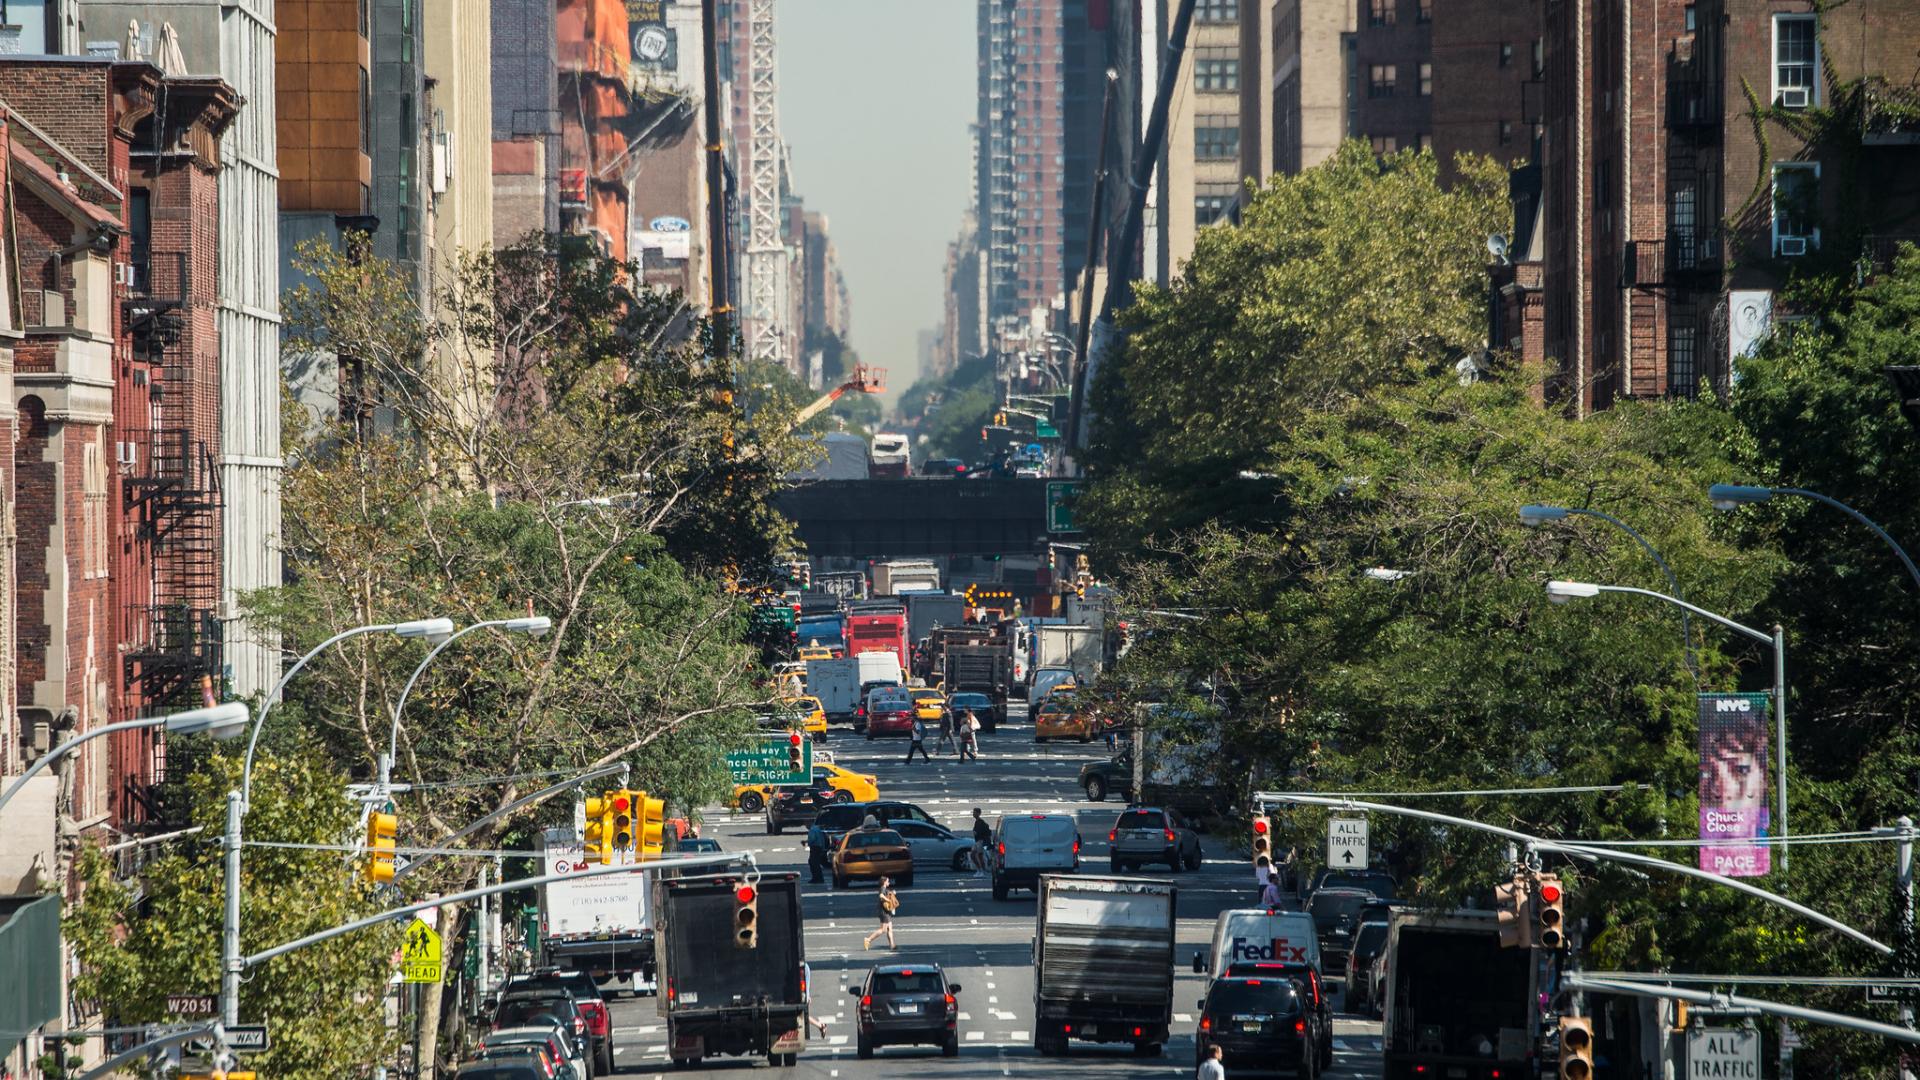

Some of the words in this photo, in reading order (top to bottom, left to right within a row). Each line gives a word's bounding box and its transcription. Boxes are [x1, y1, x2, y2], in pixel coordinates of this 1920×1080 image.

[1716, 700, 1751, 712] NYC
[1706, 811, 1744, 822] Chuck
[1338, 824, 1359, 834] ALL
[1706, 821, 1741, 832] Close
[1331, 836, 1366, 847] TRAFFIC
[1714, 856, 1756, 868] PACE
[1232, 937, 1307, 961] FedEx
[407, 968, 437, 978] HEAD
[181, 999, 197, 1013] 20
[200, 999, 212, 1013] St
[235, 1032, 261, 1044] WAY
[1707, 1037, 1739, 1055] ALL
[1693, 1060, 1755, 1079] TRAFFIC
